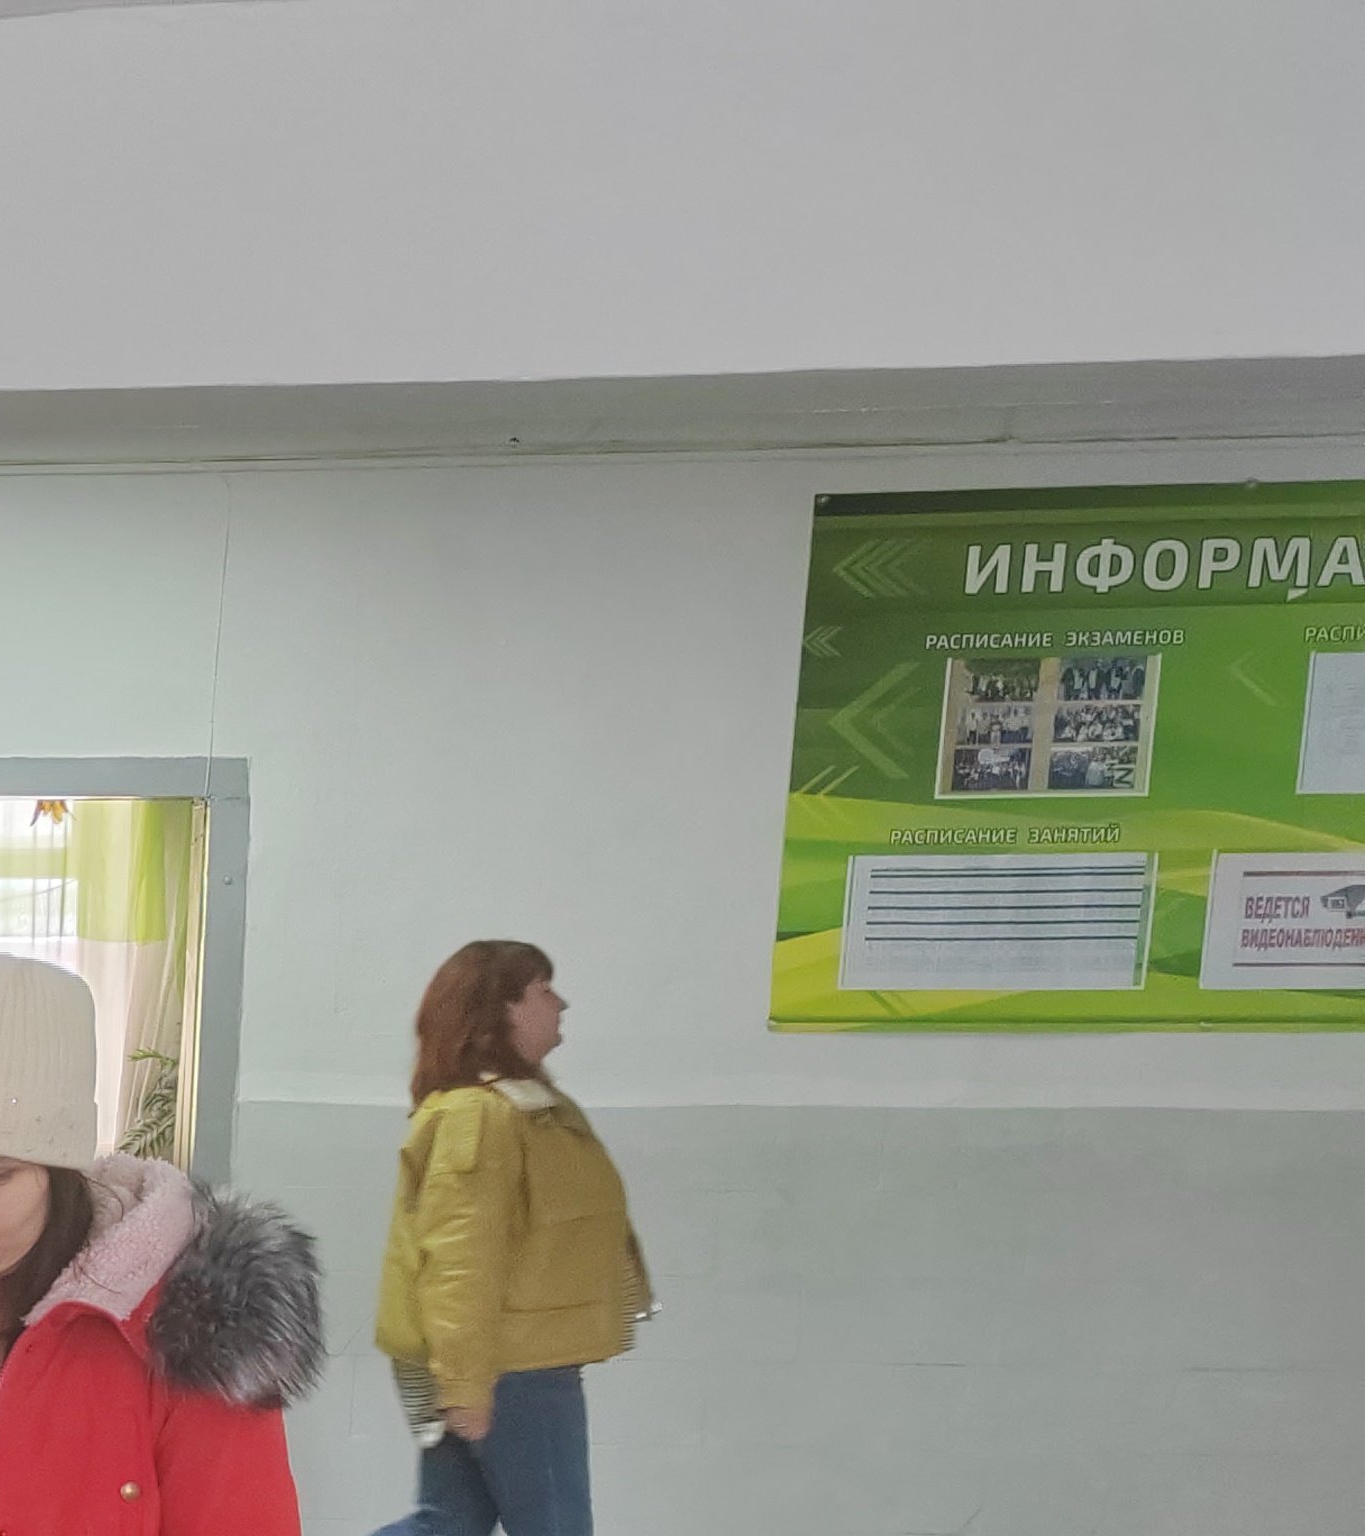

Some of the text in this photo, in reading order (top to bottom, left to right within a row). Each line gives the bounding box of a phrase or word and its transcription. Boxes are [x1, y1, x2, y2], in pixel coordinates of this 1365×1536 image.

[925, 630, 1184, 650] РАСПИСАНИЕ ЭКЗАМЕНОВ
[890, 824, 1119, 845] РАСПИСАНИЕ ЗАНЯТИЙ
[1244, 896, 1310, 923] ВЕДЕТСЯ
